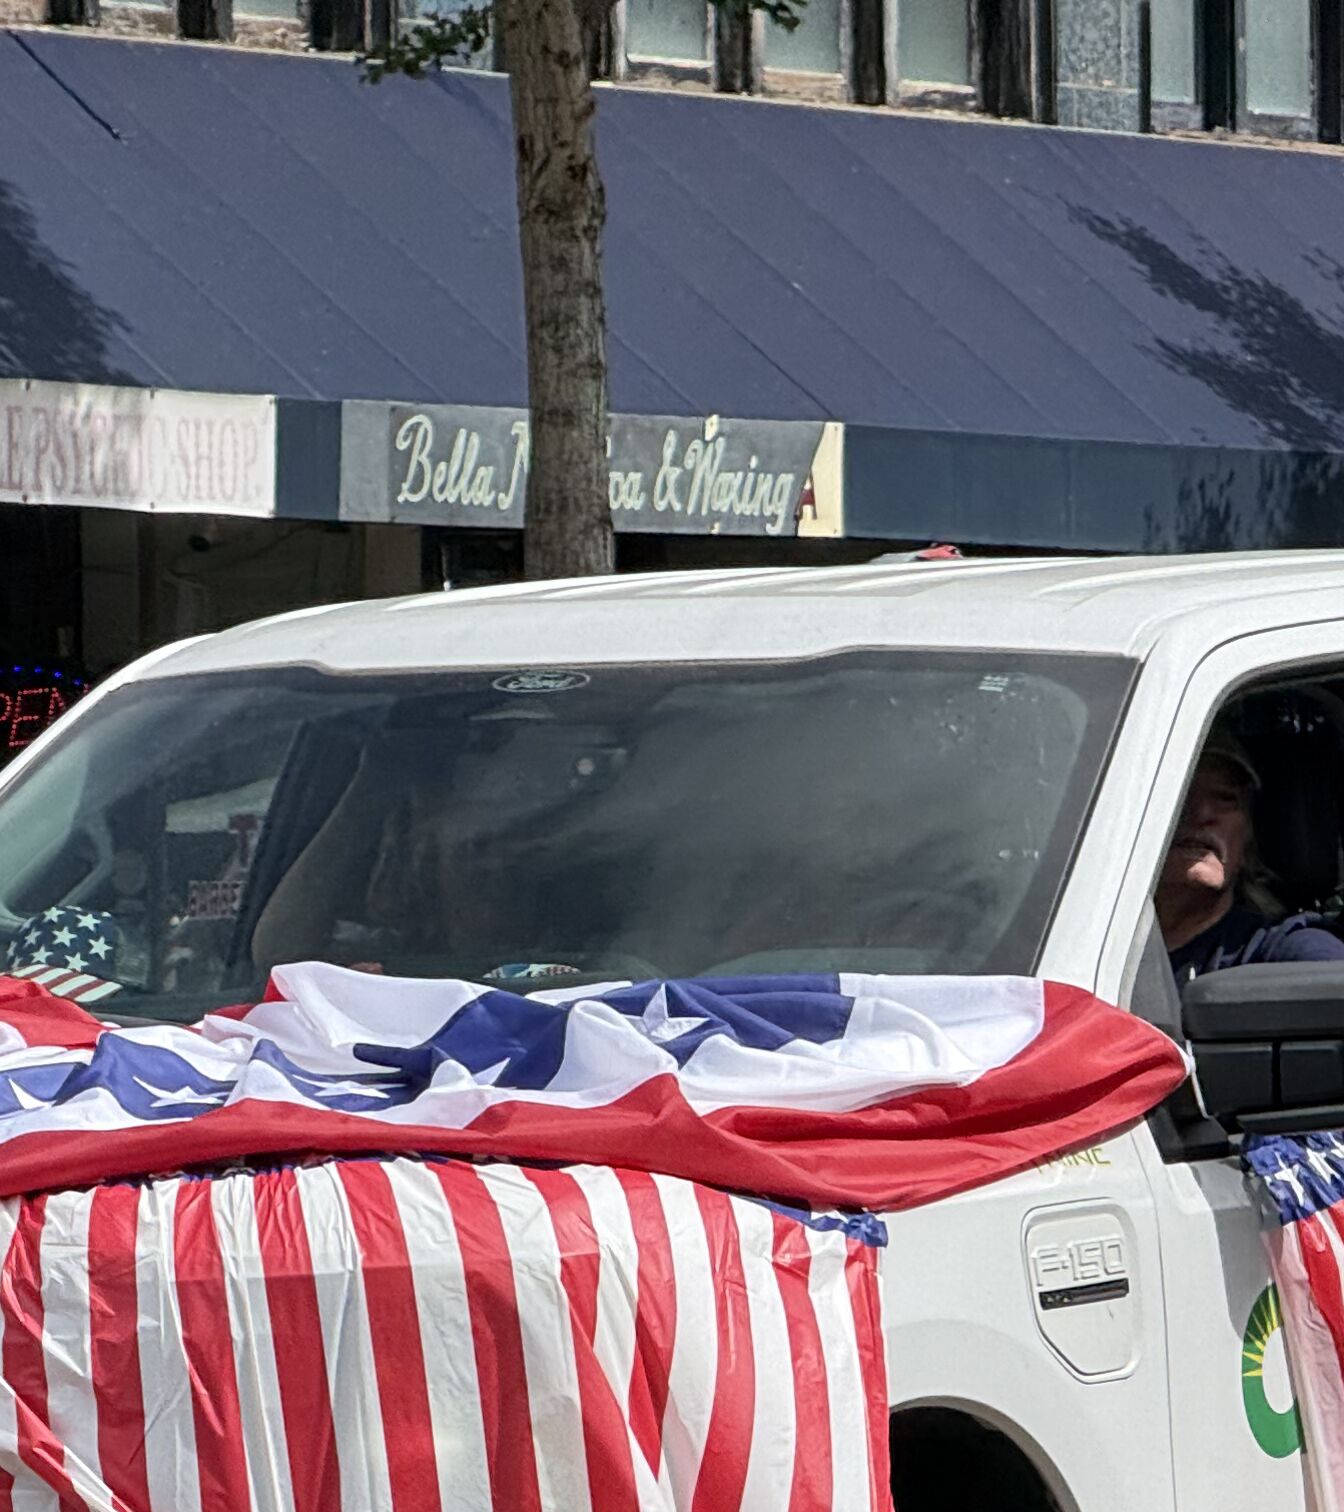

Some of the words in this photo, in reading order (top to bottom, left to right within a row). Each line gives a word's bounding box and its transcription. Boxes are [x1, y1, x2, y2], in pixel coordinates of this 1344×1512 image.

[174, 415, 260, 502] SHOP
[396, 413, 495, 506] Bella
[655, 430, 683, 512] &
[685, 432, 794, 533] Waxing
